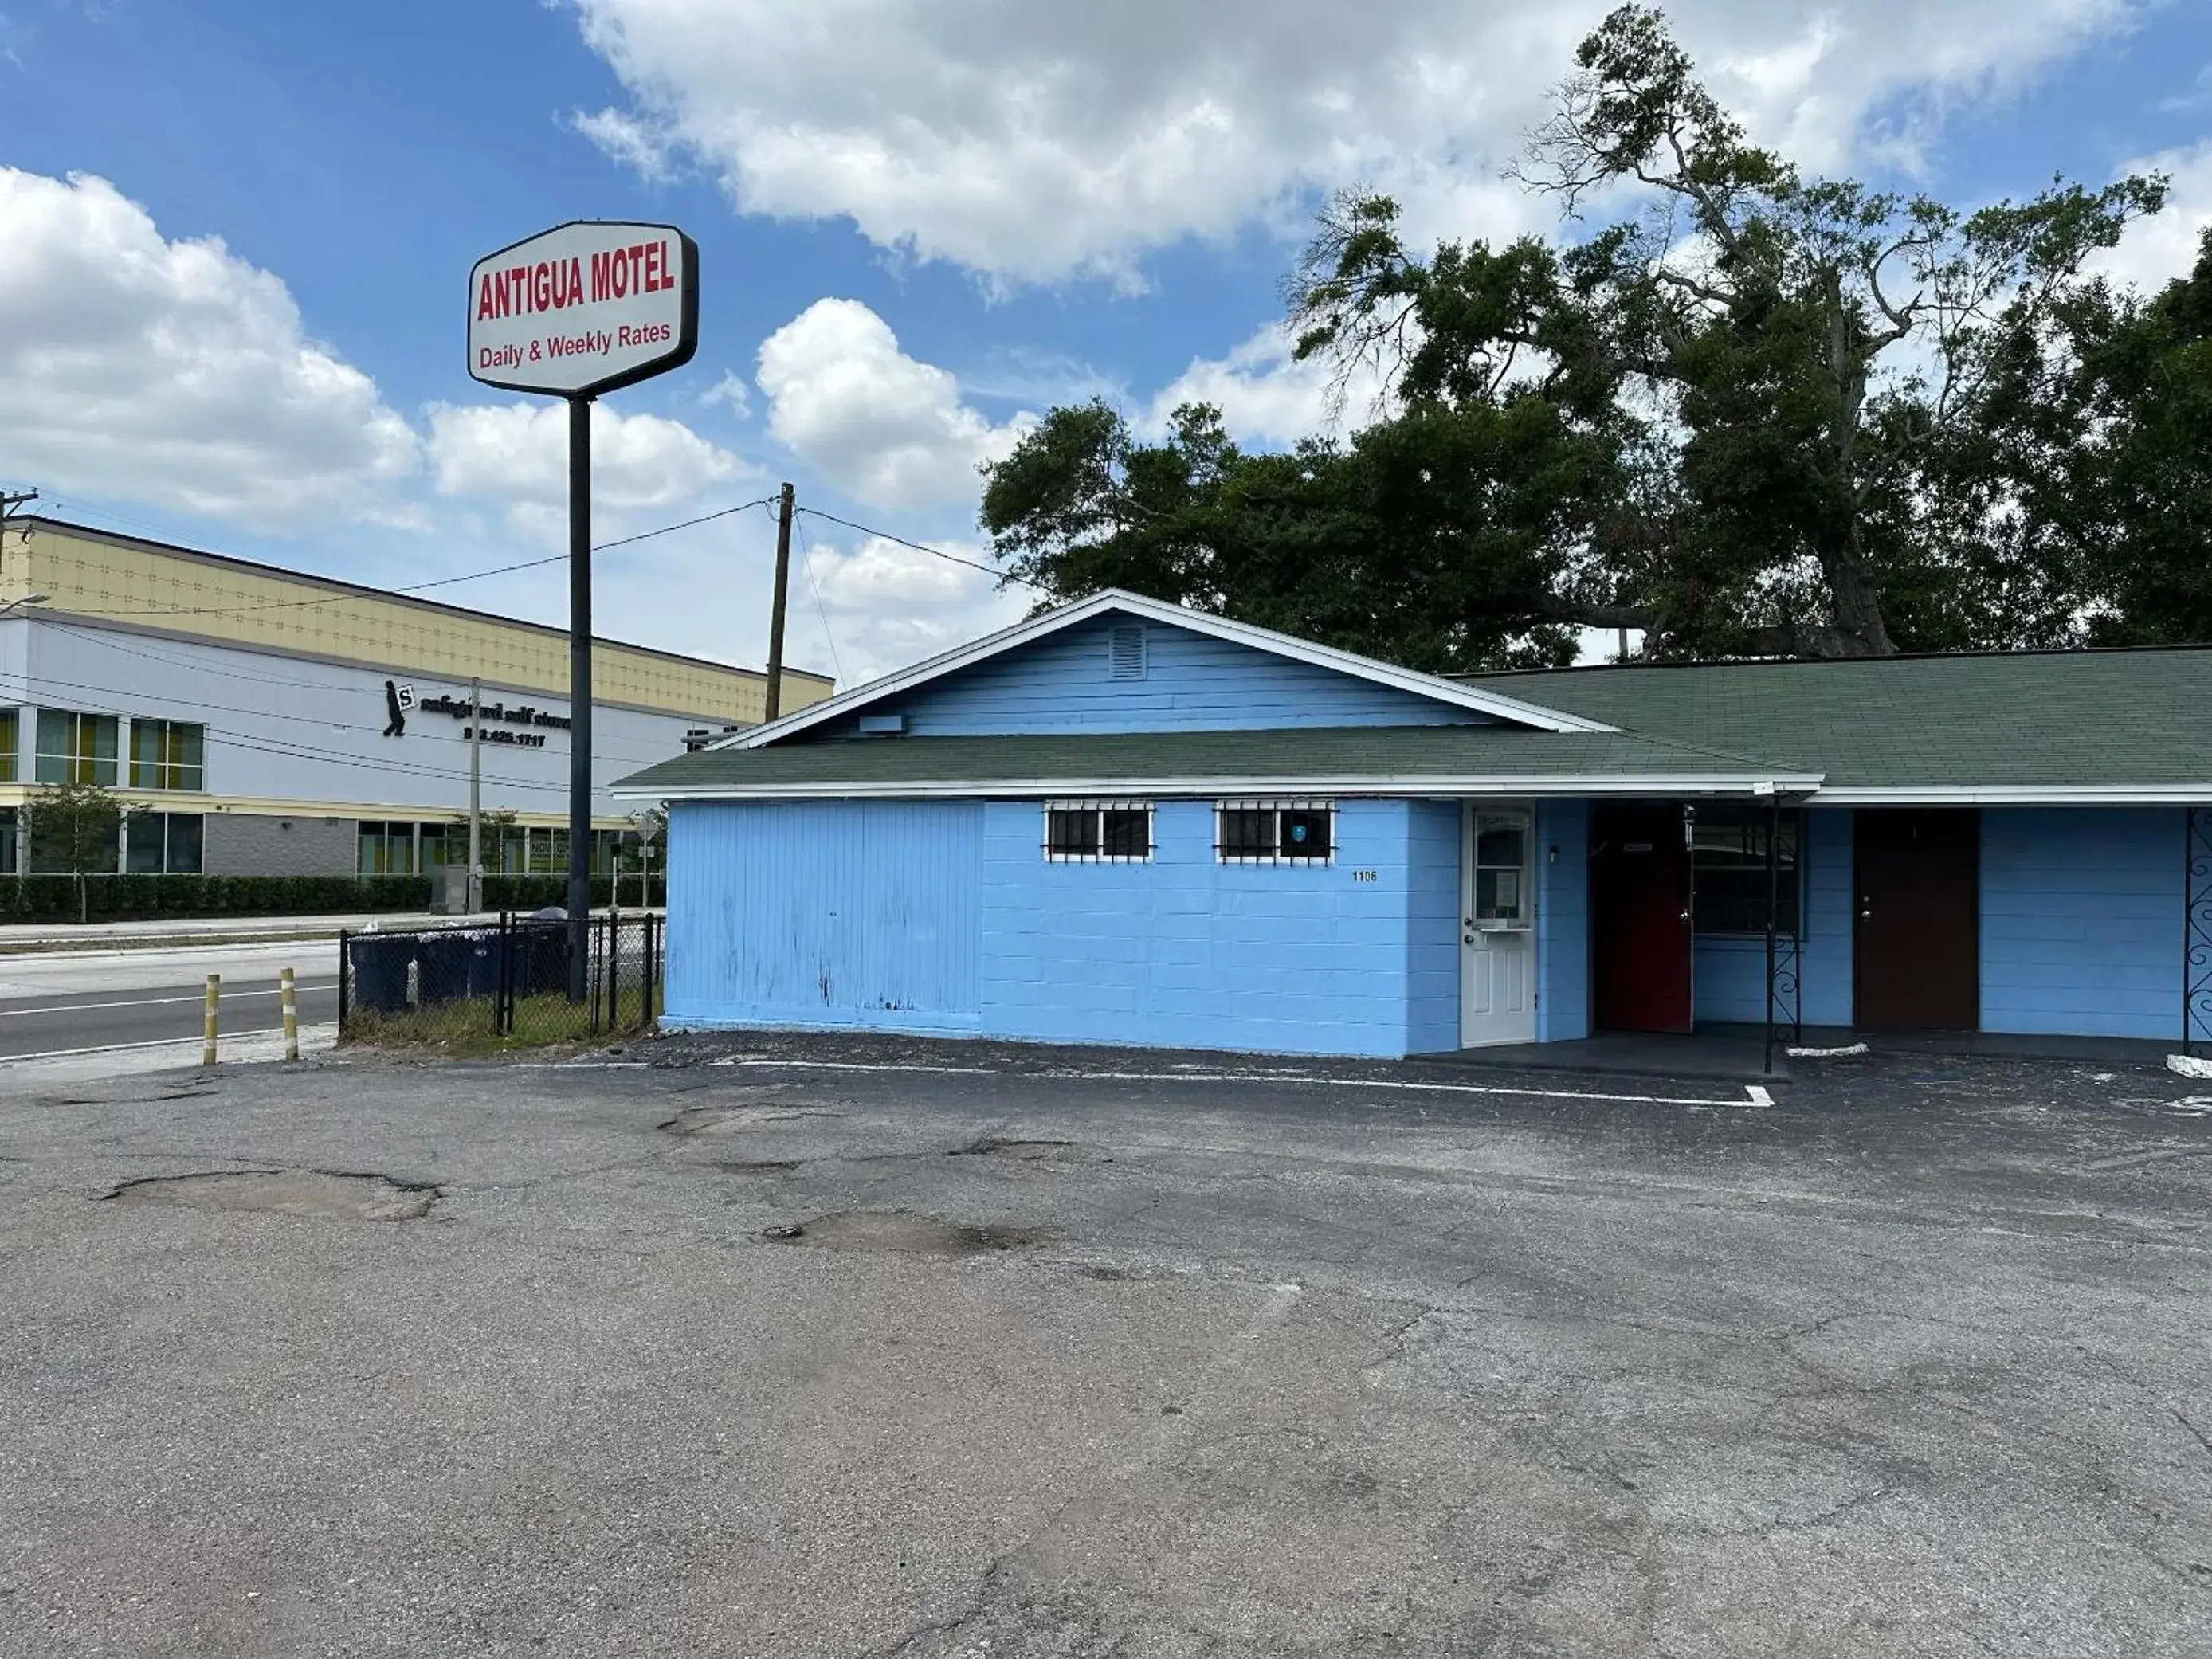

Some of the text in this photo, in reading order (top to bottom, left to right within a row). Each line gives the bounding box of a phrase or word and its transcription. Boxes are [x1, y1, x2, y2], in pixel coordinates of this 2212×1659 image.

[478, 241, 675, 320] ANTIGUA MOTEL
[480, 324, 670, 369] Daily & Weekly Rates
[399, 689, 412, 706] S
[464, 727, 546, 747] 83.425.1717
[1352, 871, 1377, 882] 1106
